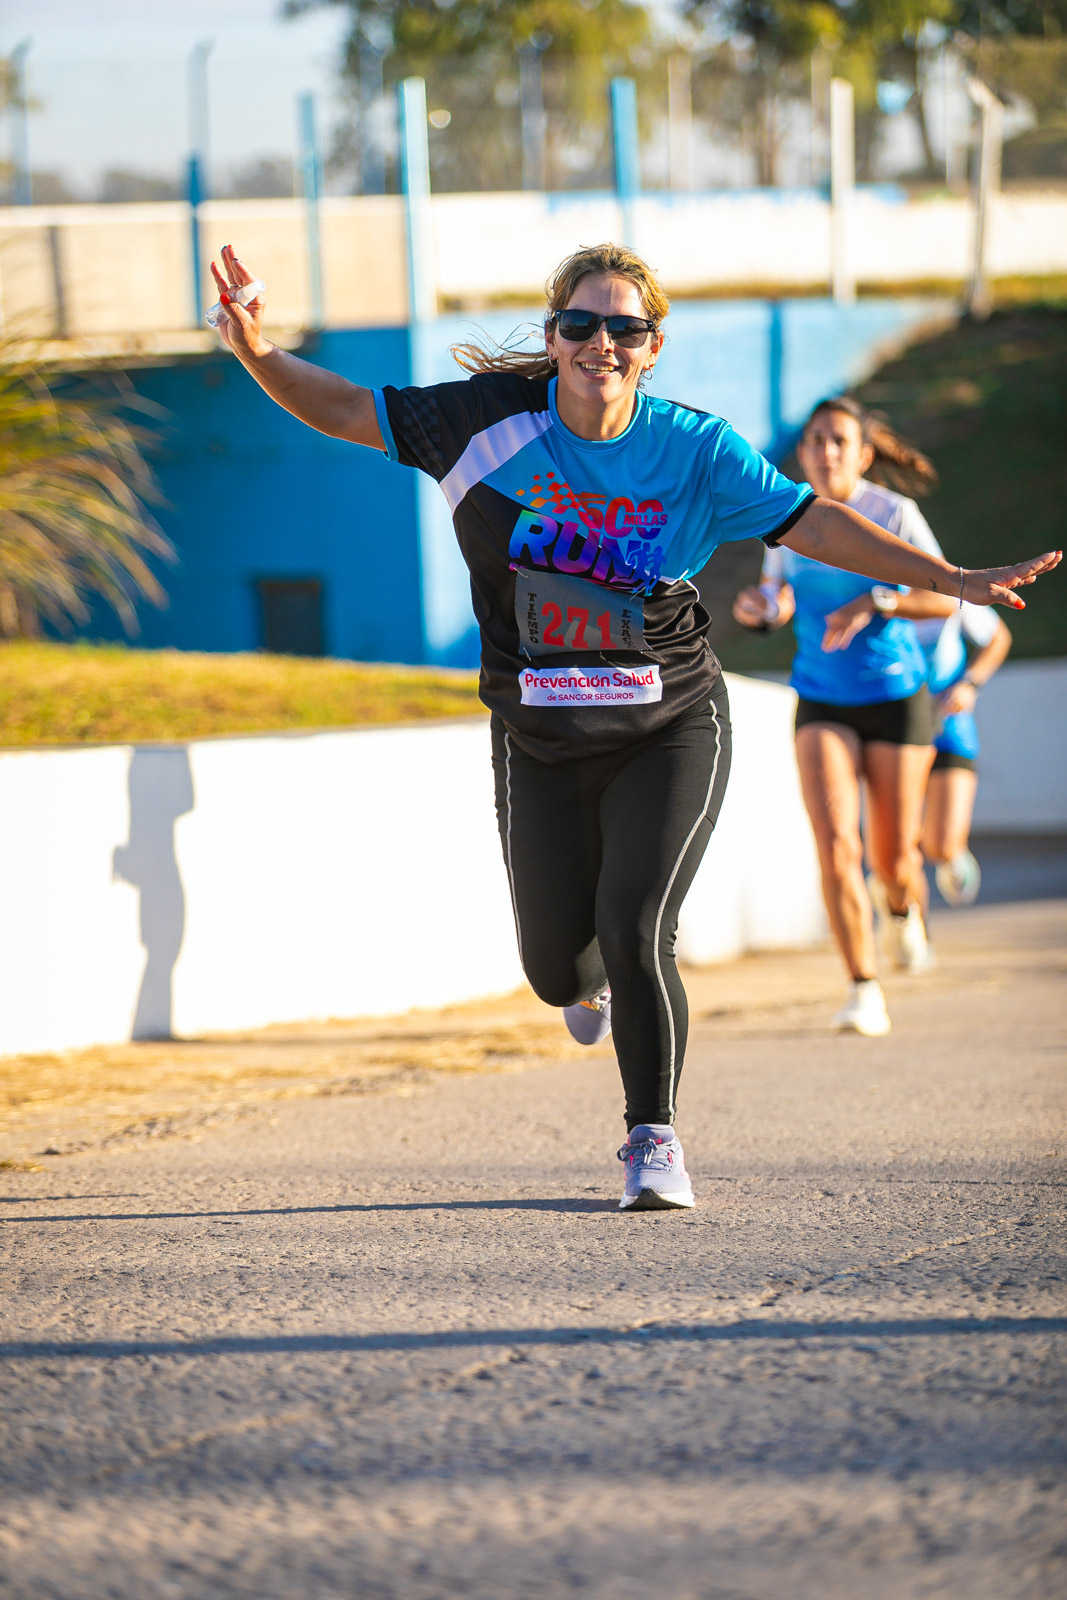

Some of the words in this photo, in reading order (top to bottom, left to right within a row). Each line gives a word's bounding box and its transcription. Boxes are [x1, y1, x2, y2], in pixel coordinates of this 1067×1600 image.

[623, 514, 668, 526] MILLAS
[508, 509, 643, 582] RUN
[527, 592, 539, 644] TIEMPO
[541, 602, 618, 649] 271
[621, 609, 635, 649] EXAC
[525, 673, 610, 689] Prevención
[612, 670, 655, 688] Salud
[547, 693, 557, 702] de
[558, 694, 593, 702] SANCOR
[594, 692, 634, 701] SEGUROS
